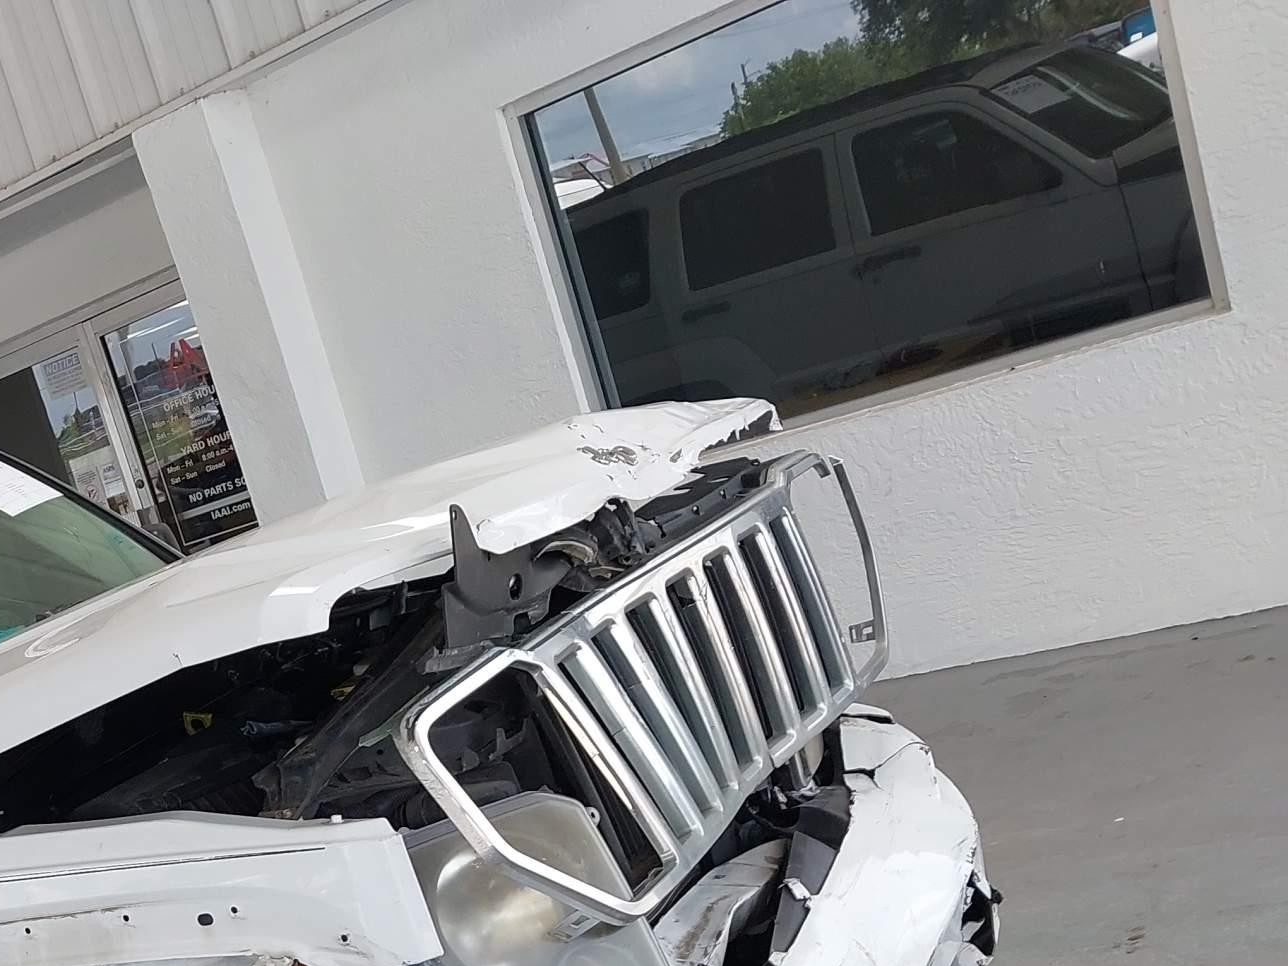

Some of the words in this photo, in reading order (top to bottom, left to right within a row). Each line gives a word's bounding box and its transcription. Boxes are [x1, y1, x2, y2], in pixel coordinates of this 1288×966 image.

[45, 354, 80, 375] NOTICE
[163, 393, 194, 412] OFFICE
[180, 440, 206, 455] YARD
[167, 464, 181, 475] Mon
[185, 458, 194, 468] Fri
[170, 476, 181, 485] Sat
[185, 471, 198, 480] Sun
[205, 459, 226, 473] Closed
[188, 491, 203, 504] NO
[204, 481, 233, 498] PARTS
[210, 502, 251, 520] IAAI.com
